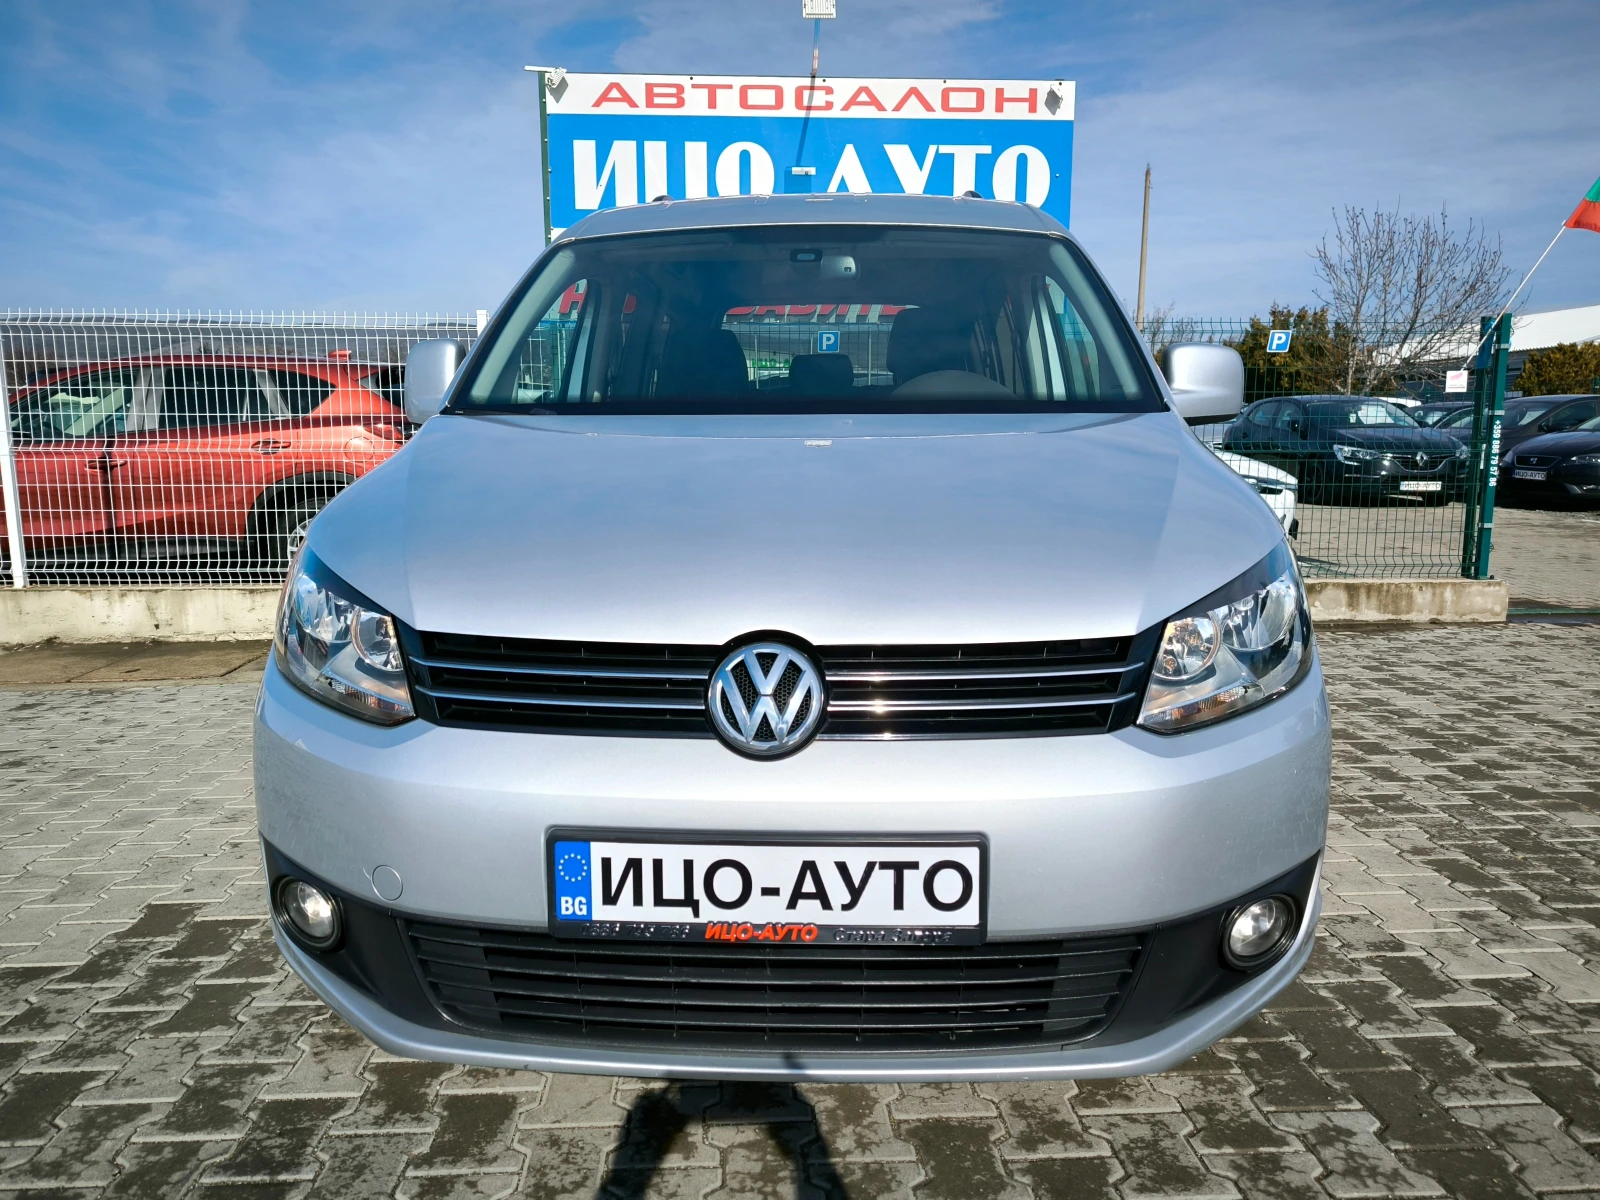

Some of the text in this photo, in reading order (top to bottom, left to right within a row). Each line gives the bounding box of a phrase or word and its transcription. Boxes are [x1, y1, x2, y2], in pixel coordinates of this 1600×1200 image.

[590, 81, 1039, 114] АВТОСАЛОН
[822, 333, 835, 350] P
[1271, 332, 1287, 350] P
[1489, 420, 1502, 487] +359 886 79 57 86
[600, 856, 974, 918] ИЦО-АУТО
[560, 896, 588, 916] BG
[704, 922, 818, 943] ИЦО-АУТО
